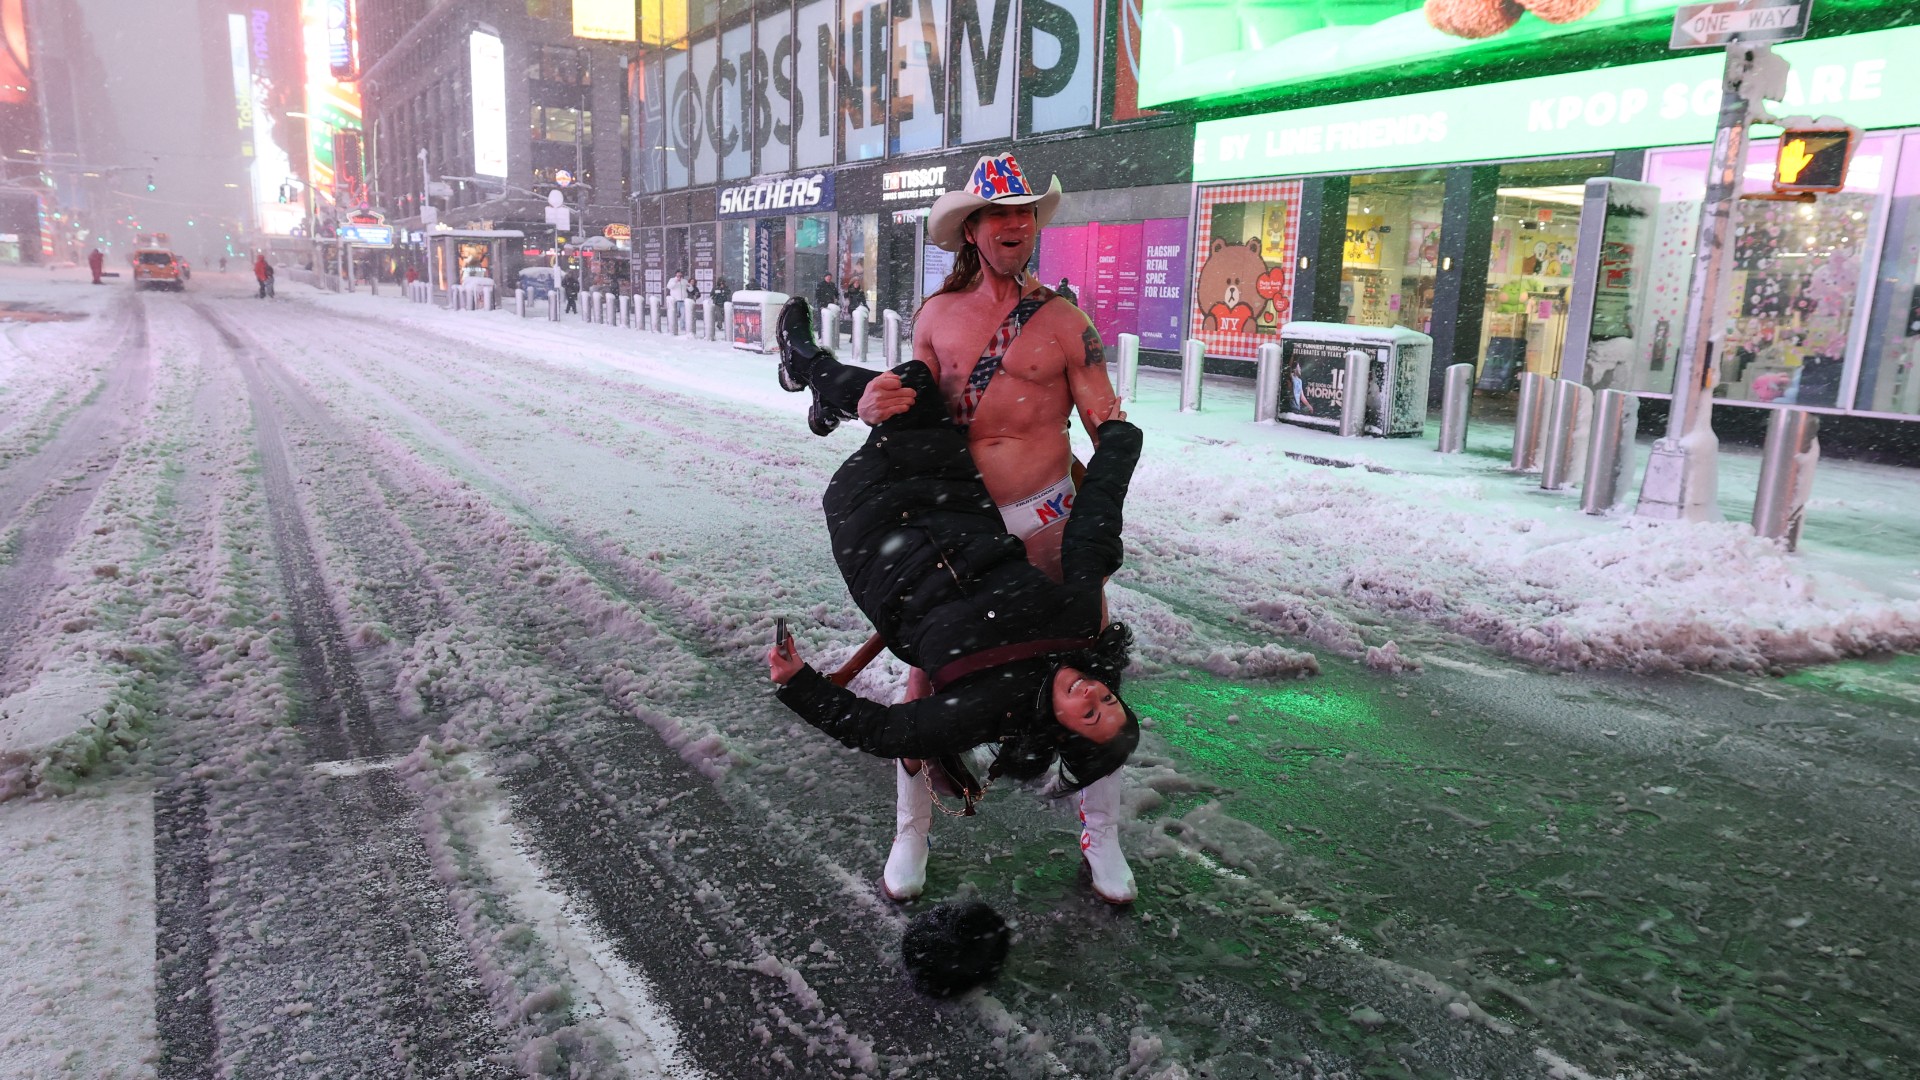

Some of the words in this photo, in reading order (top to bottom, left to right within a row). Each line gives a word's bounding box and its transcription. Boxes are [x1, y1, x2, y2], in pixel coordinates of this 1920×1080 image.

[1694, 15, 1731, 33] ONE
[1749, 8, 1791, 29] WAY
[705, 33, 804, 158] CBS
[1527, 86, 1648, 132] KPOP
[1658, 58, 1887, 121] SQARE
[1219, 135, 1249, 161] BY
[1265, 125, 1322, 157] LINE
[1325, 110, 1449, 151] FRIENDS
[900, 166, 946, 189] TISSOT
[974, 156, 1022, 186] NAKE
[719, 175, 824, 214] SKECHERS
[1147, 245, 1180, 258] FLAGSHIP
[1146, 259, 1169, 271] RETAIL
[1145, 273, 1167, 285] SPACE
[1144, 286, 1158, 298] FOR
[1160, 287, 1180, 299] LEASE
[1220, 317, 1240, 331] NY
[1292, 348, 1320, 356] CELEBRATES
[1302, 343, 1325, 351] FUNNIEST
[1307, 386, 1344, 400] MORMO
[1036, 492, 1073, 525] NYC
